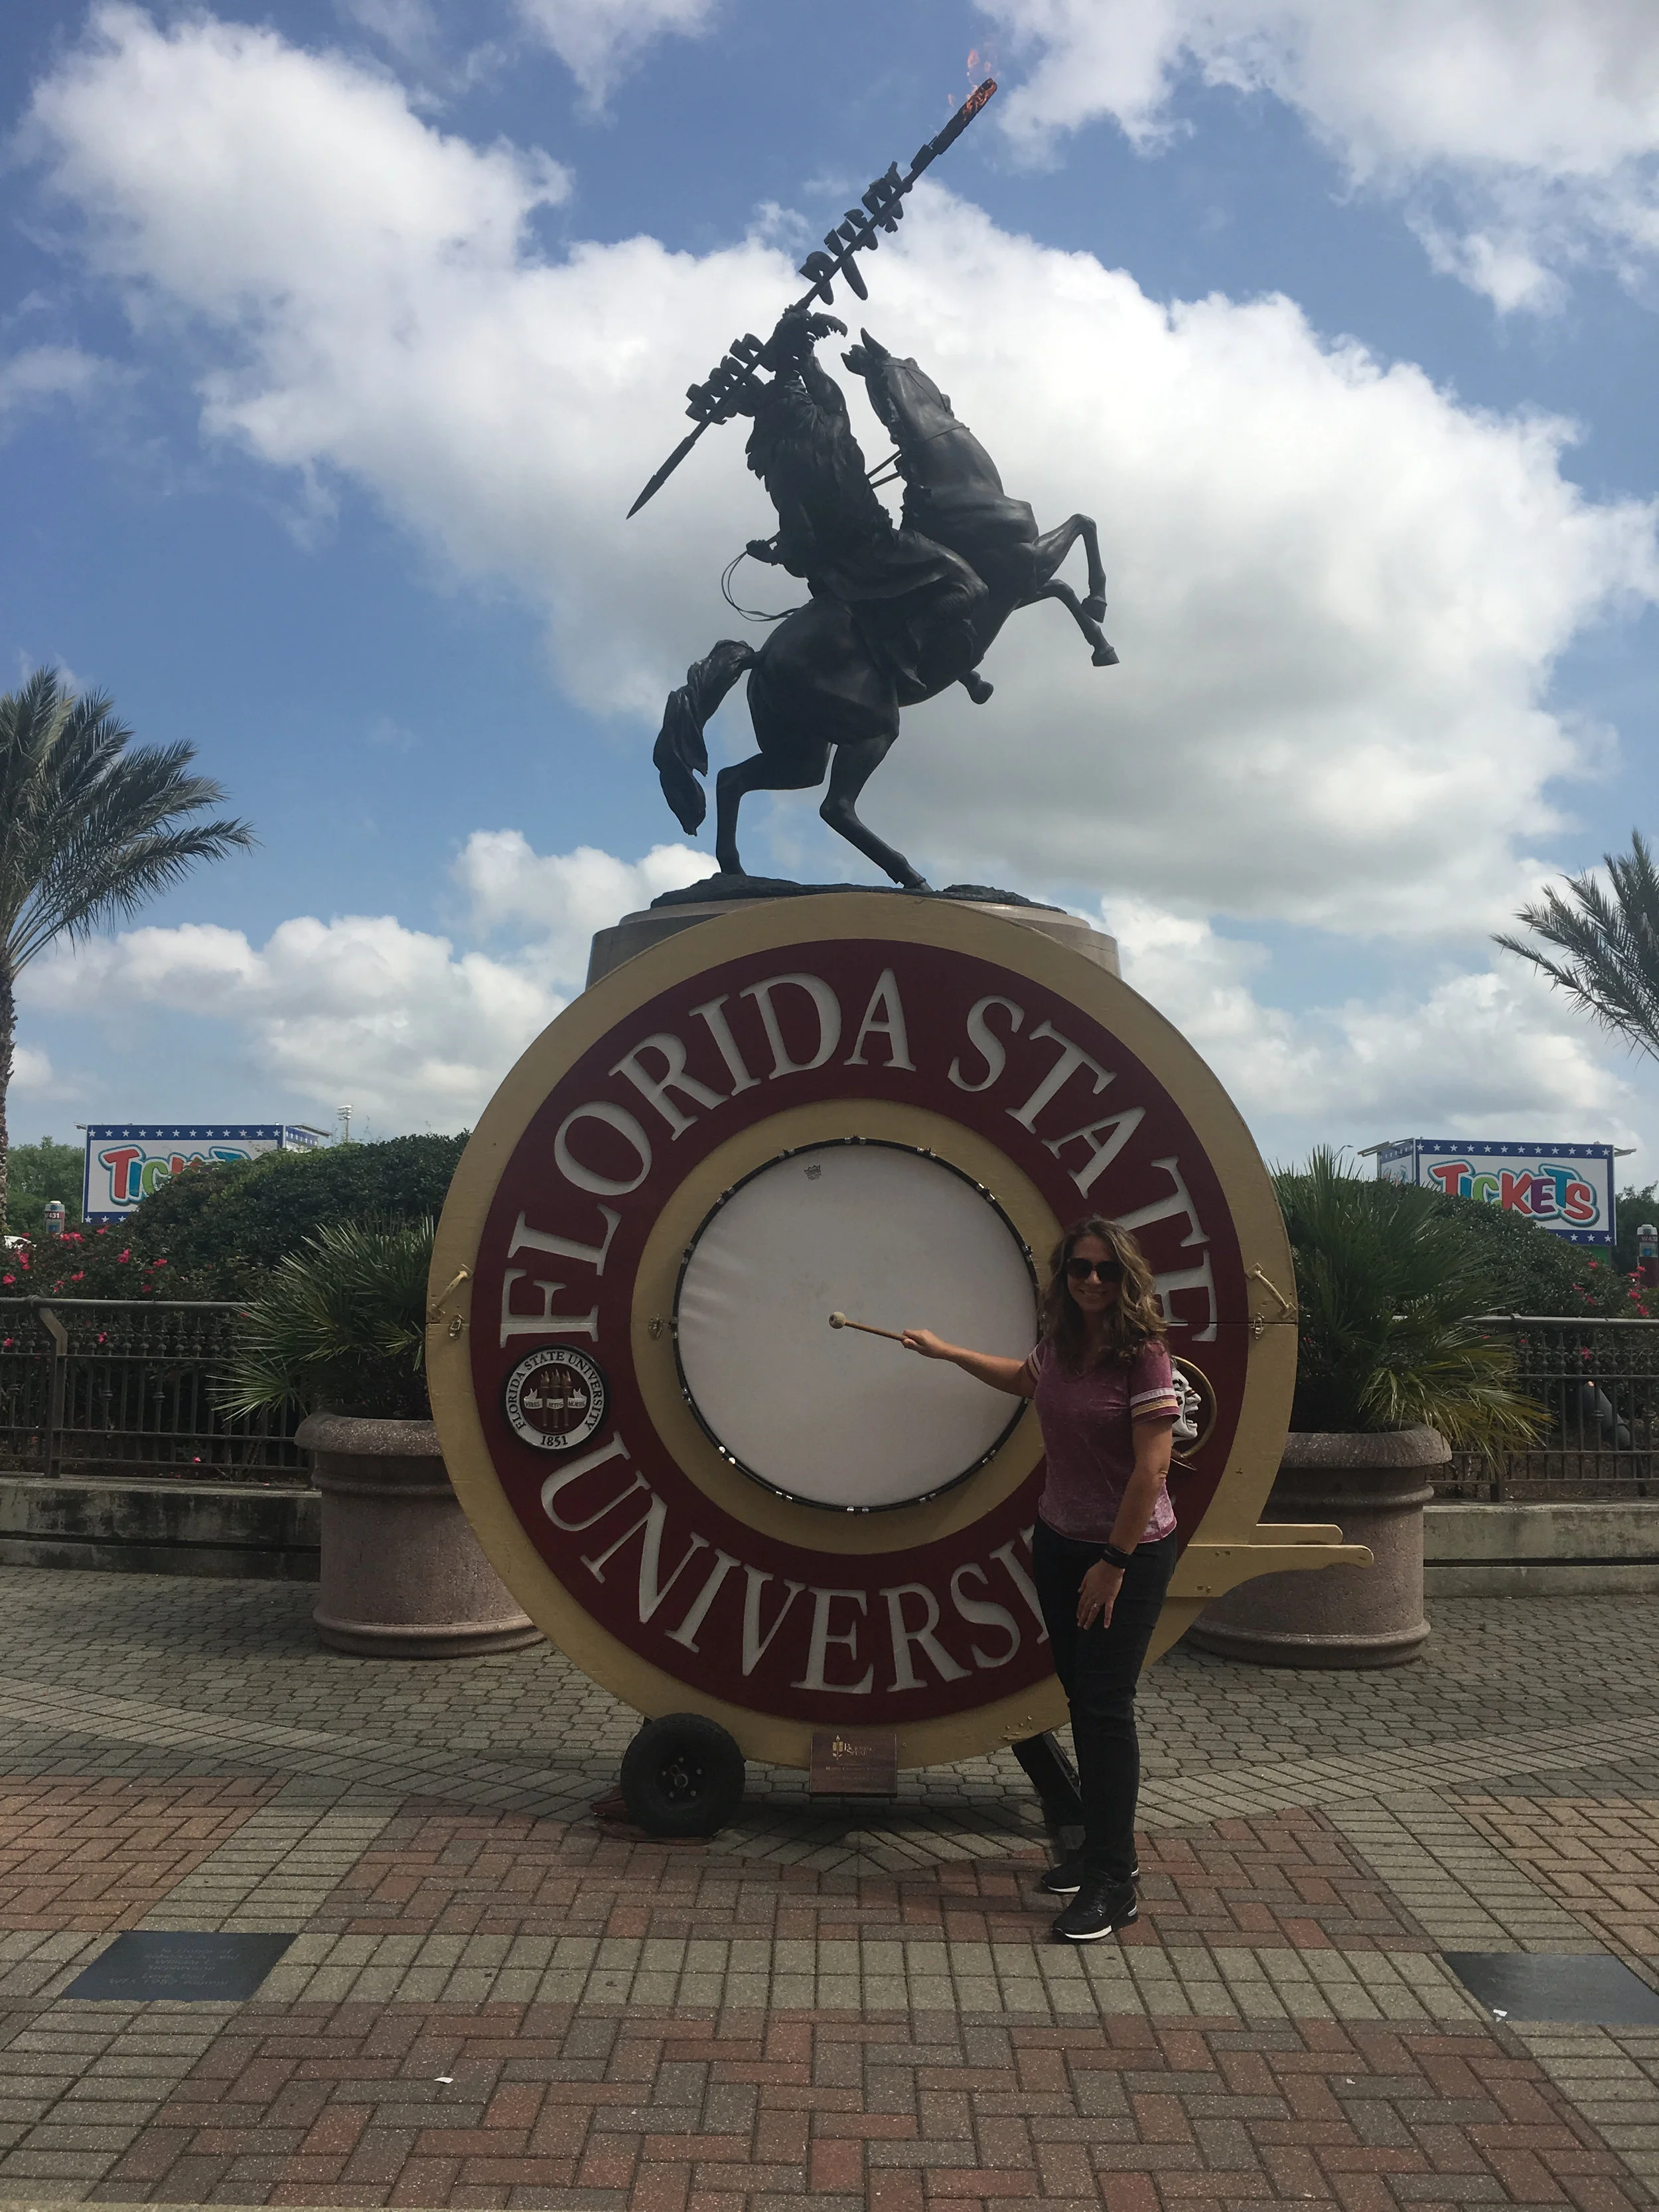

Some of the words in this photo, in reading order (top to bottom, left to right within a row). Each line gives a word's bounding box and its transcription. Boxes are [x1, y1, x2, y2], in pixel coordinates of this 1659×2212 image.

[500, 967, 917, 1348] FLORIDA
[1431, 1163, 1594, 1220] TICKETS
[508, 1371, 526, 1430] FLORIDA
[524, 1351, 565, 1370] STATE
[569, 1354, 603, 1430] UNIVERSITY
[540, 1435, 569, 1447] 1851
[541, 1430, 1050, 1694] UNIVERSI
